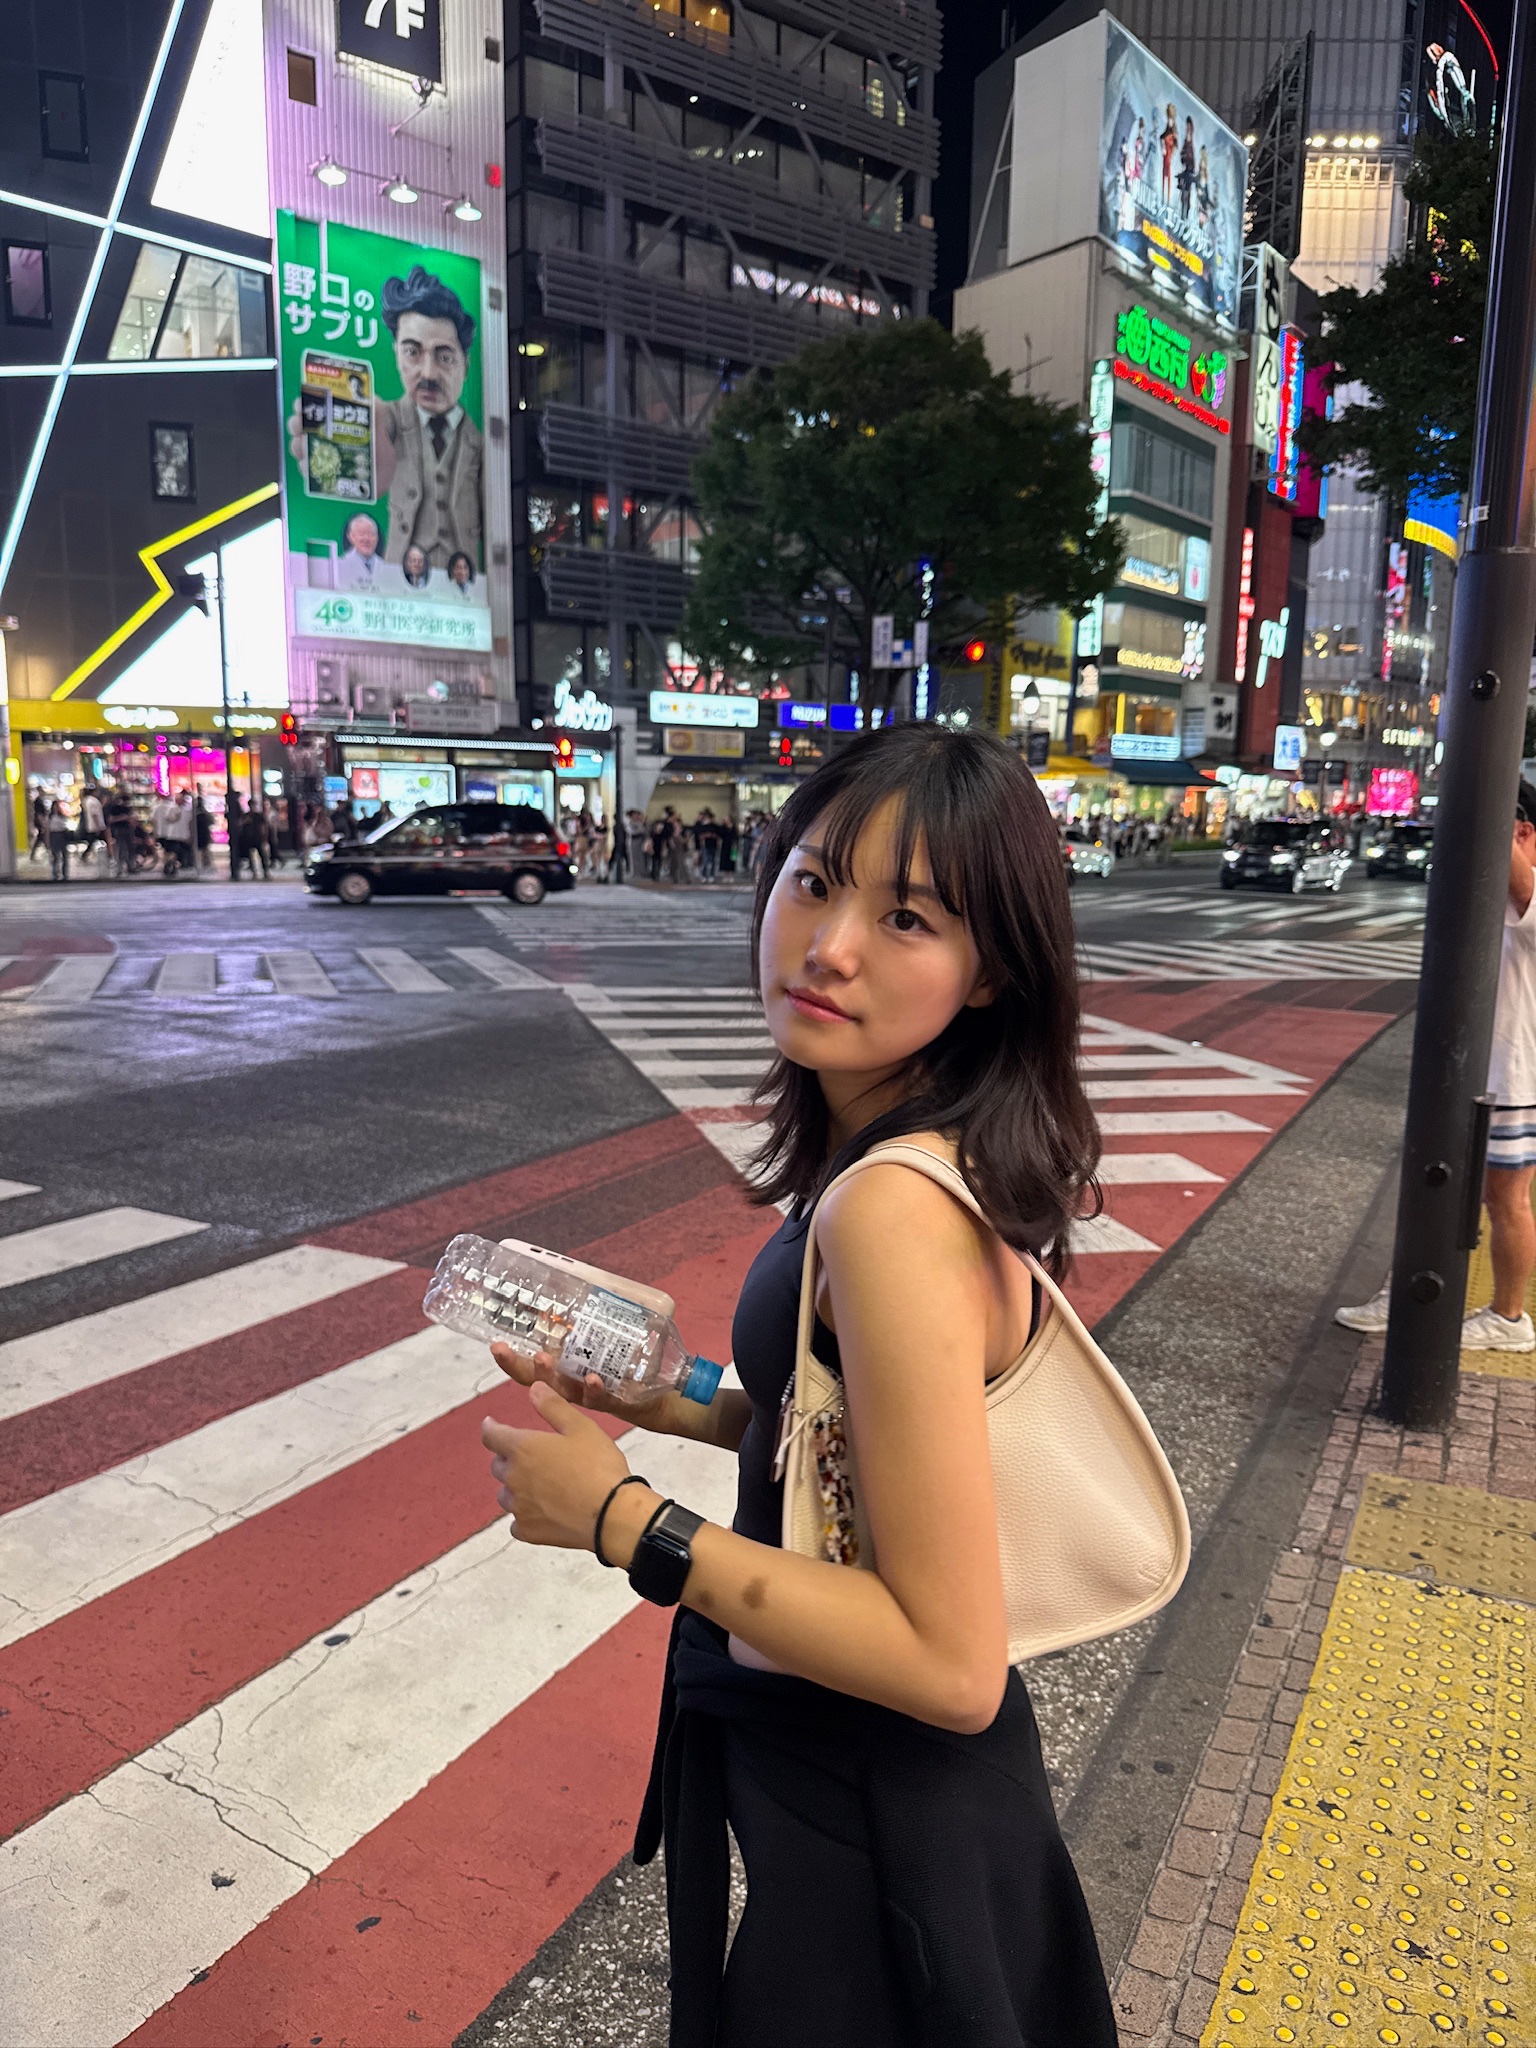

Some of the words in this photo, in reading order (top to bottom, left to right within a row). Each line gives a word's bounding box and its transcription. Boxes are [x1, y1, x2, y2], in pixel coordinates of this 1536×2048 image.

[283, 261, 375, 312] 野口の
[284, 300, 379, 348] サプリ
[363, 610, 477, 638] 野口医学研究所
